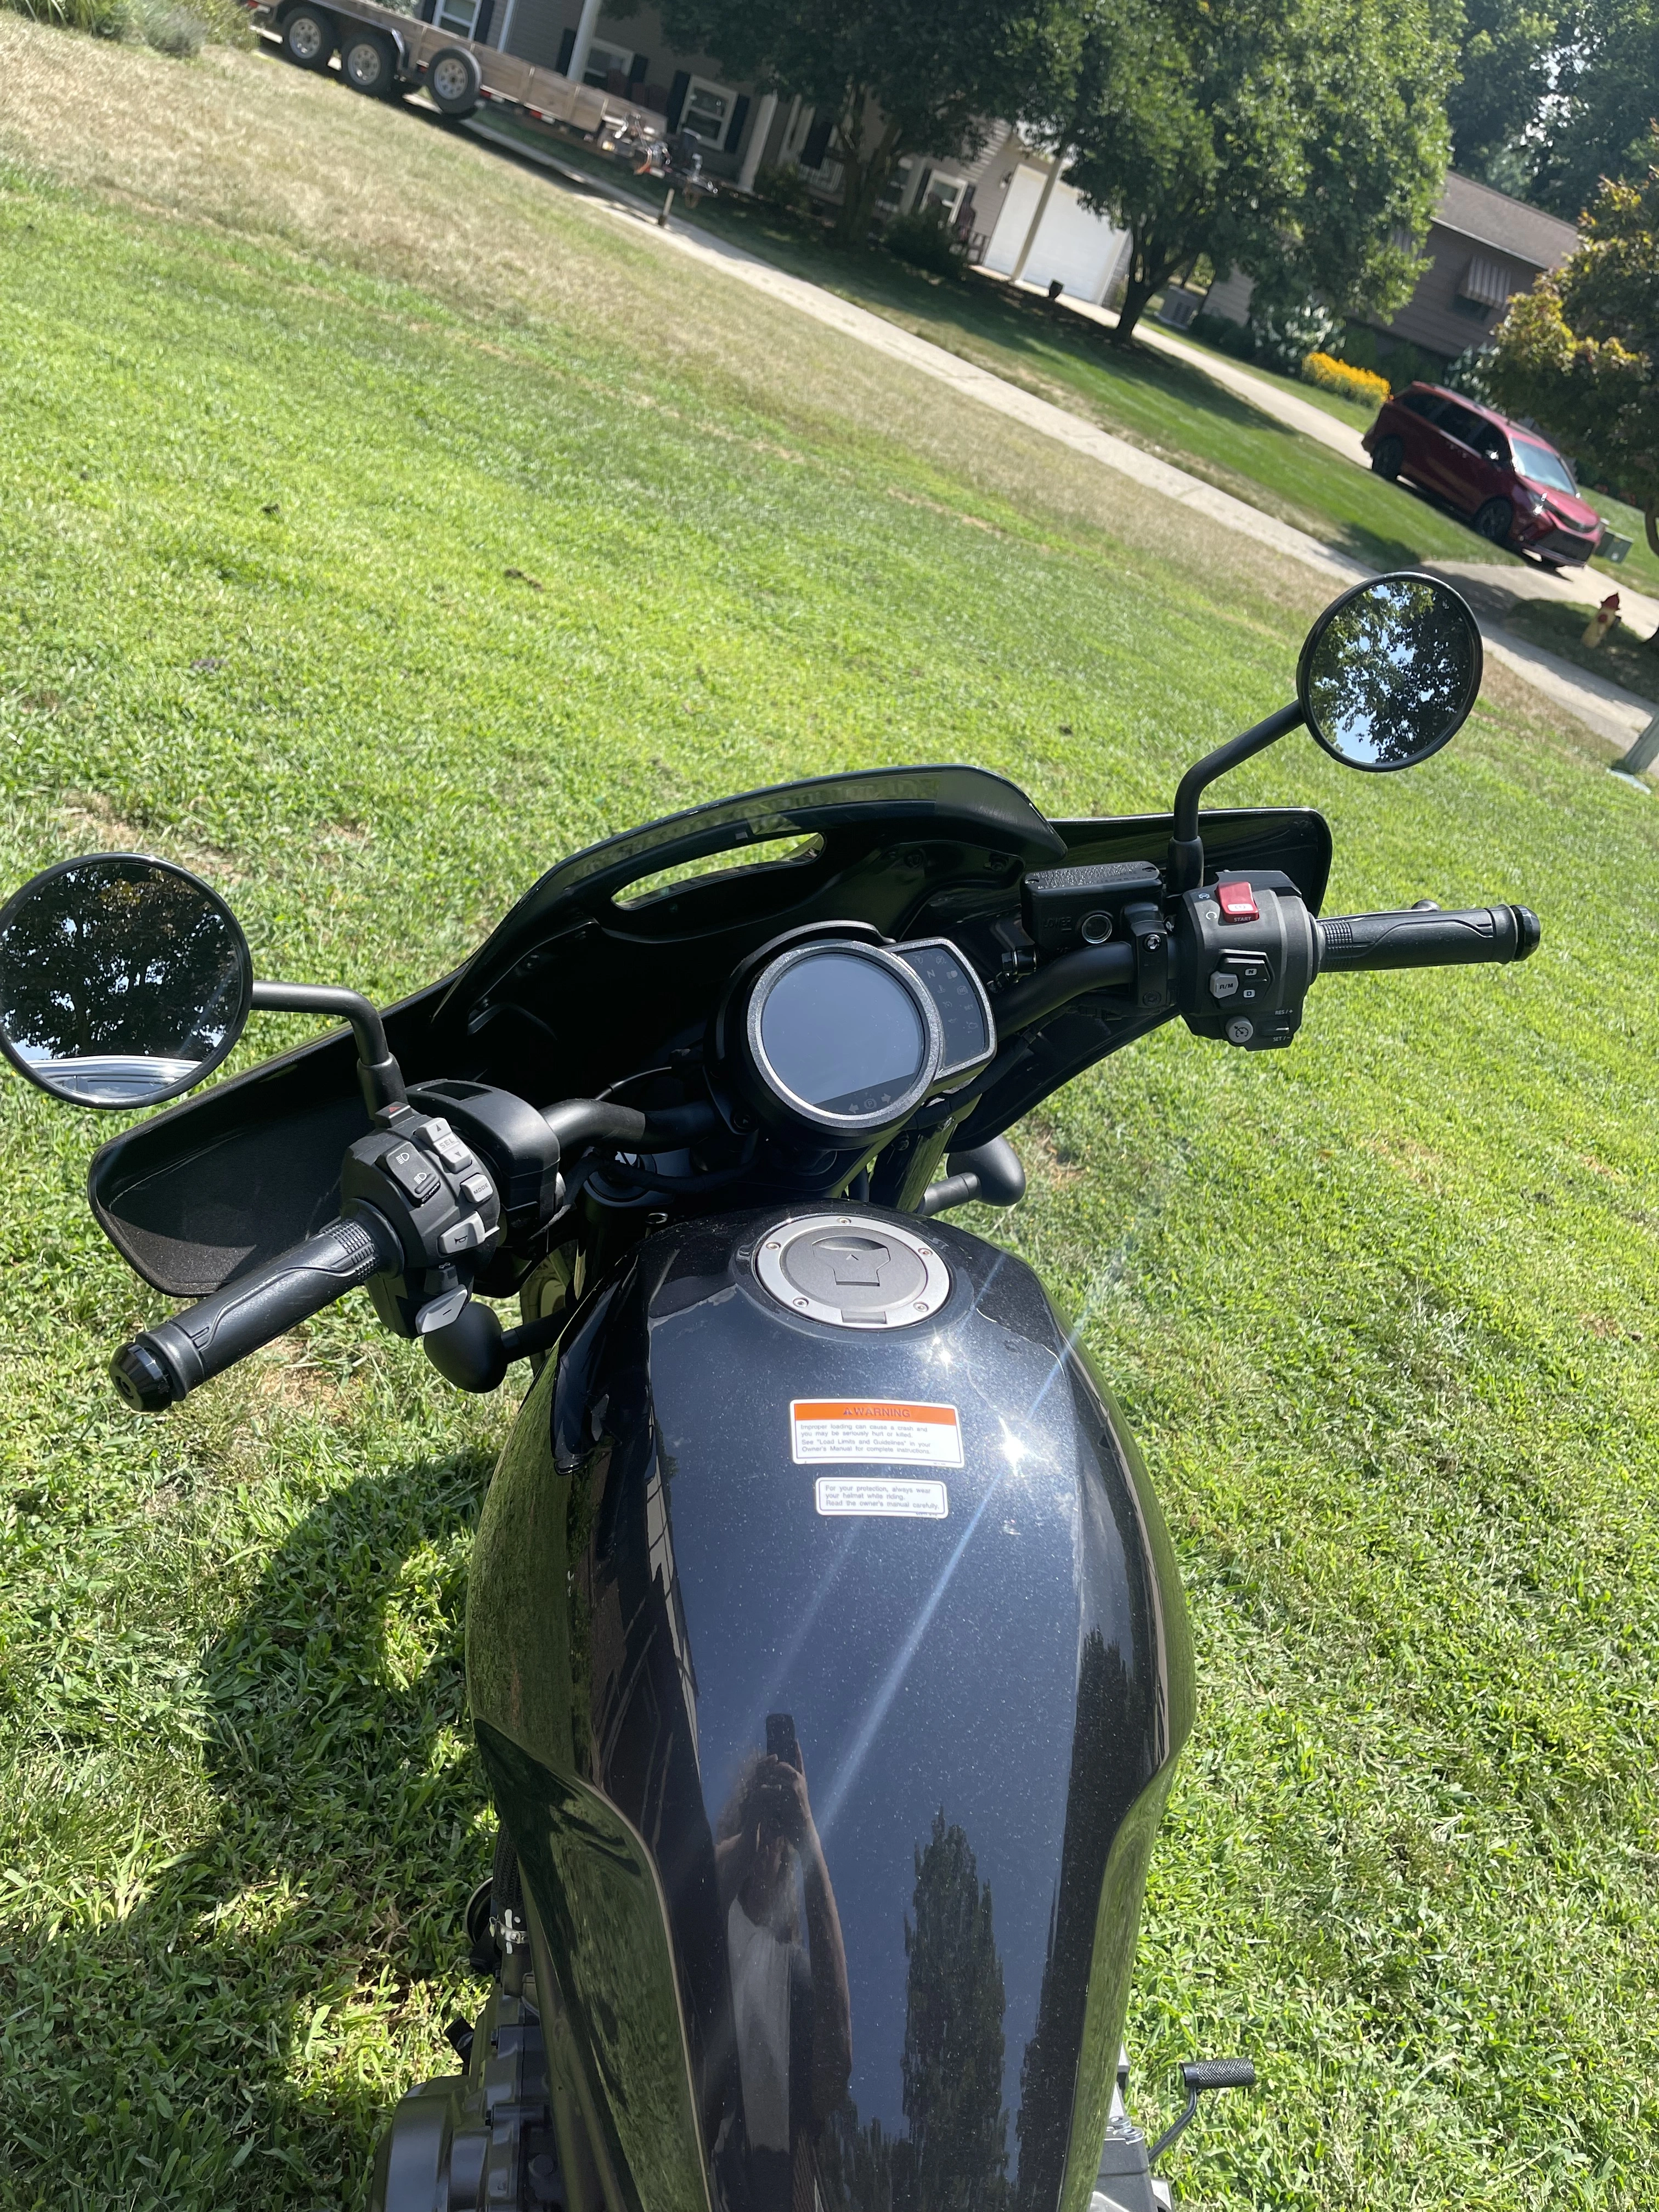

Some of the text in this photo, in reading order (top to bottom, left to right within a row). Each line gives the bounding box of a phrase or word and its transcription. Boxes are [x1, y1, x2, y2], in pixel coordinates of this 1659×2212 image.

[927, 969, 935, 978] N
[439, 1138, 455, 1149] SEL
[473, 1183, 489, 1195] MODE
[854, 1407, 911, 1418] WARNING
[913, 1502, 939, 1510] carefully.
